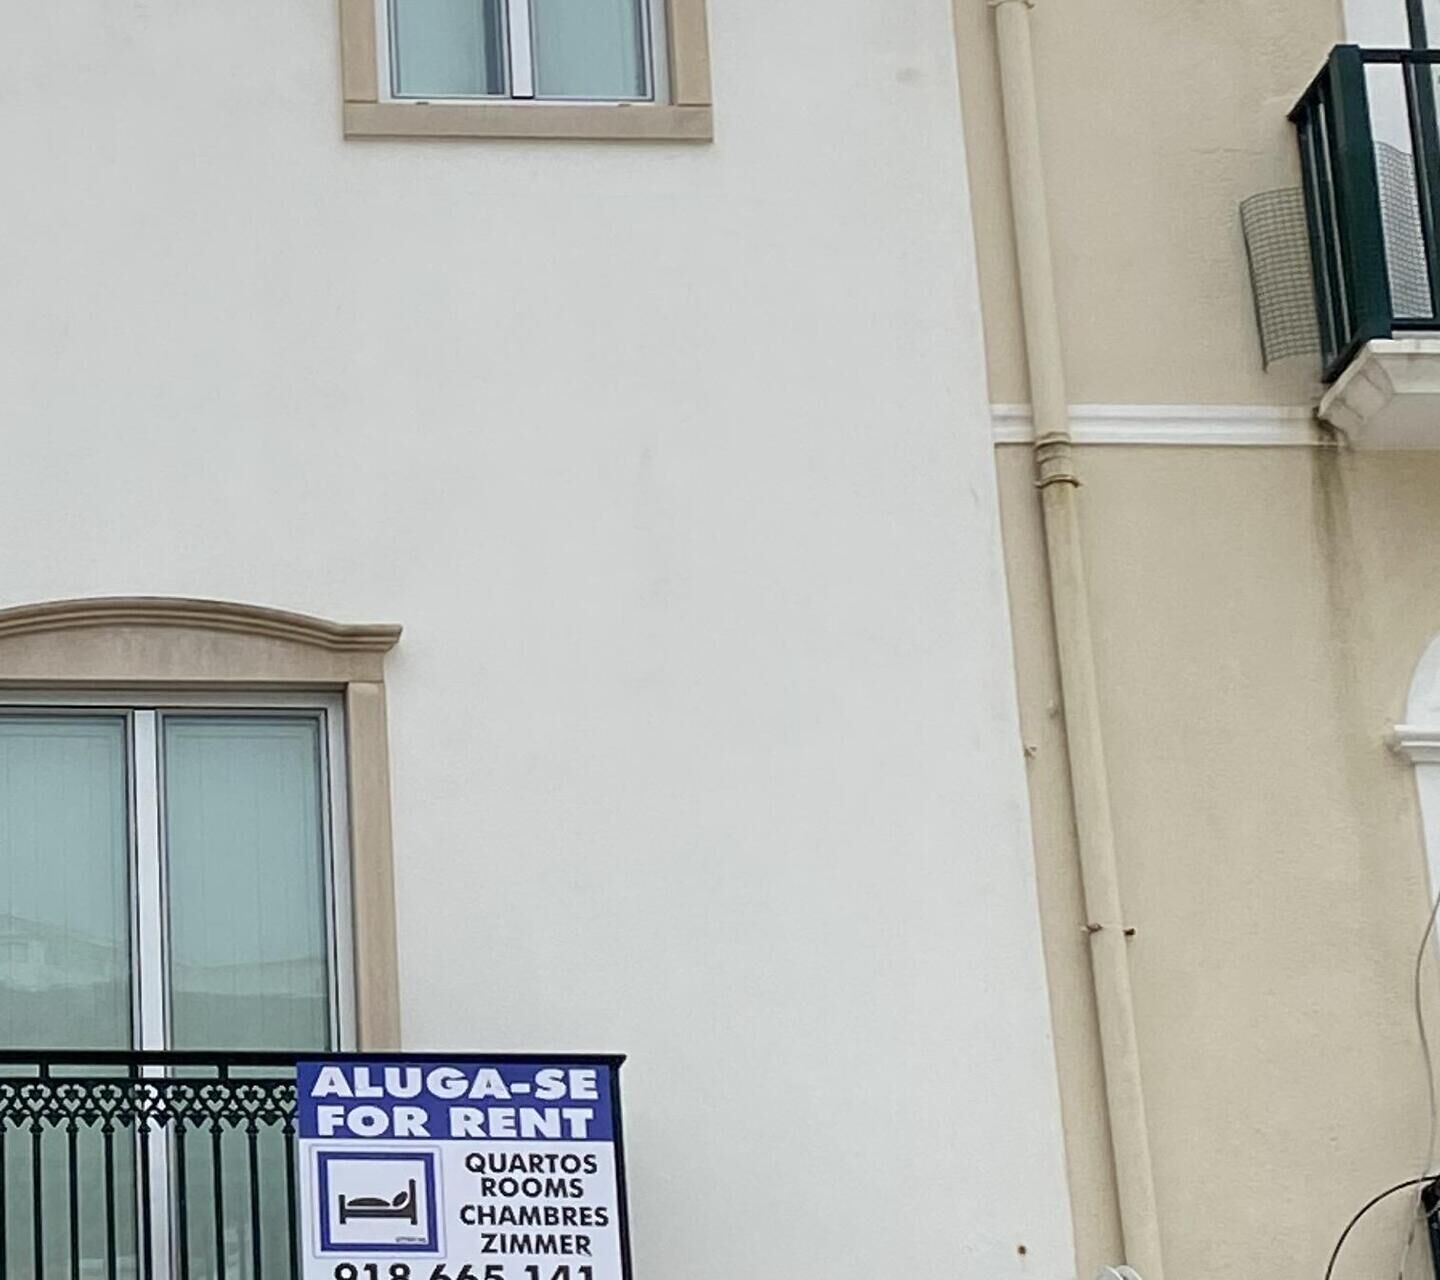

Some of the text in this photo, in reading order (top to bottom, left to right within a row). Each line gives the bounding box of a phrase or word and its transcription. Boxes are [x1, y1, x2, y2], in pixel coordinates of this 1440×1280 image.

[311, 1067, 599, 1099] ALUGA-SE
[317, 1105, 594, 1139] FOR RENT
[465, 1153, 598, 1174] QUARTOS
[481, 1177, 584, 1198] ROOMS
[460, 1205, 609, 1227] CHAMBRES
[481, 1233, 592, 1256] ZIMMER
